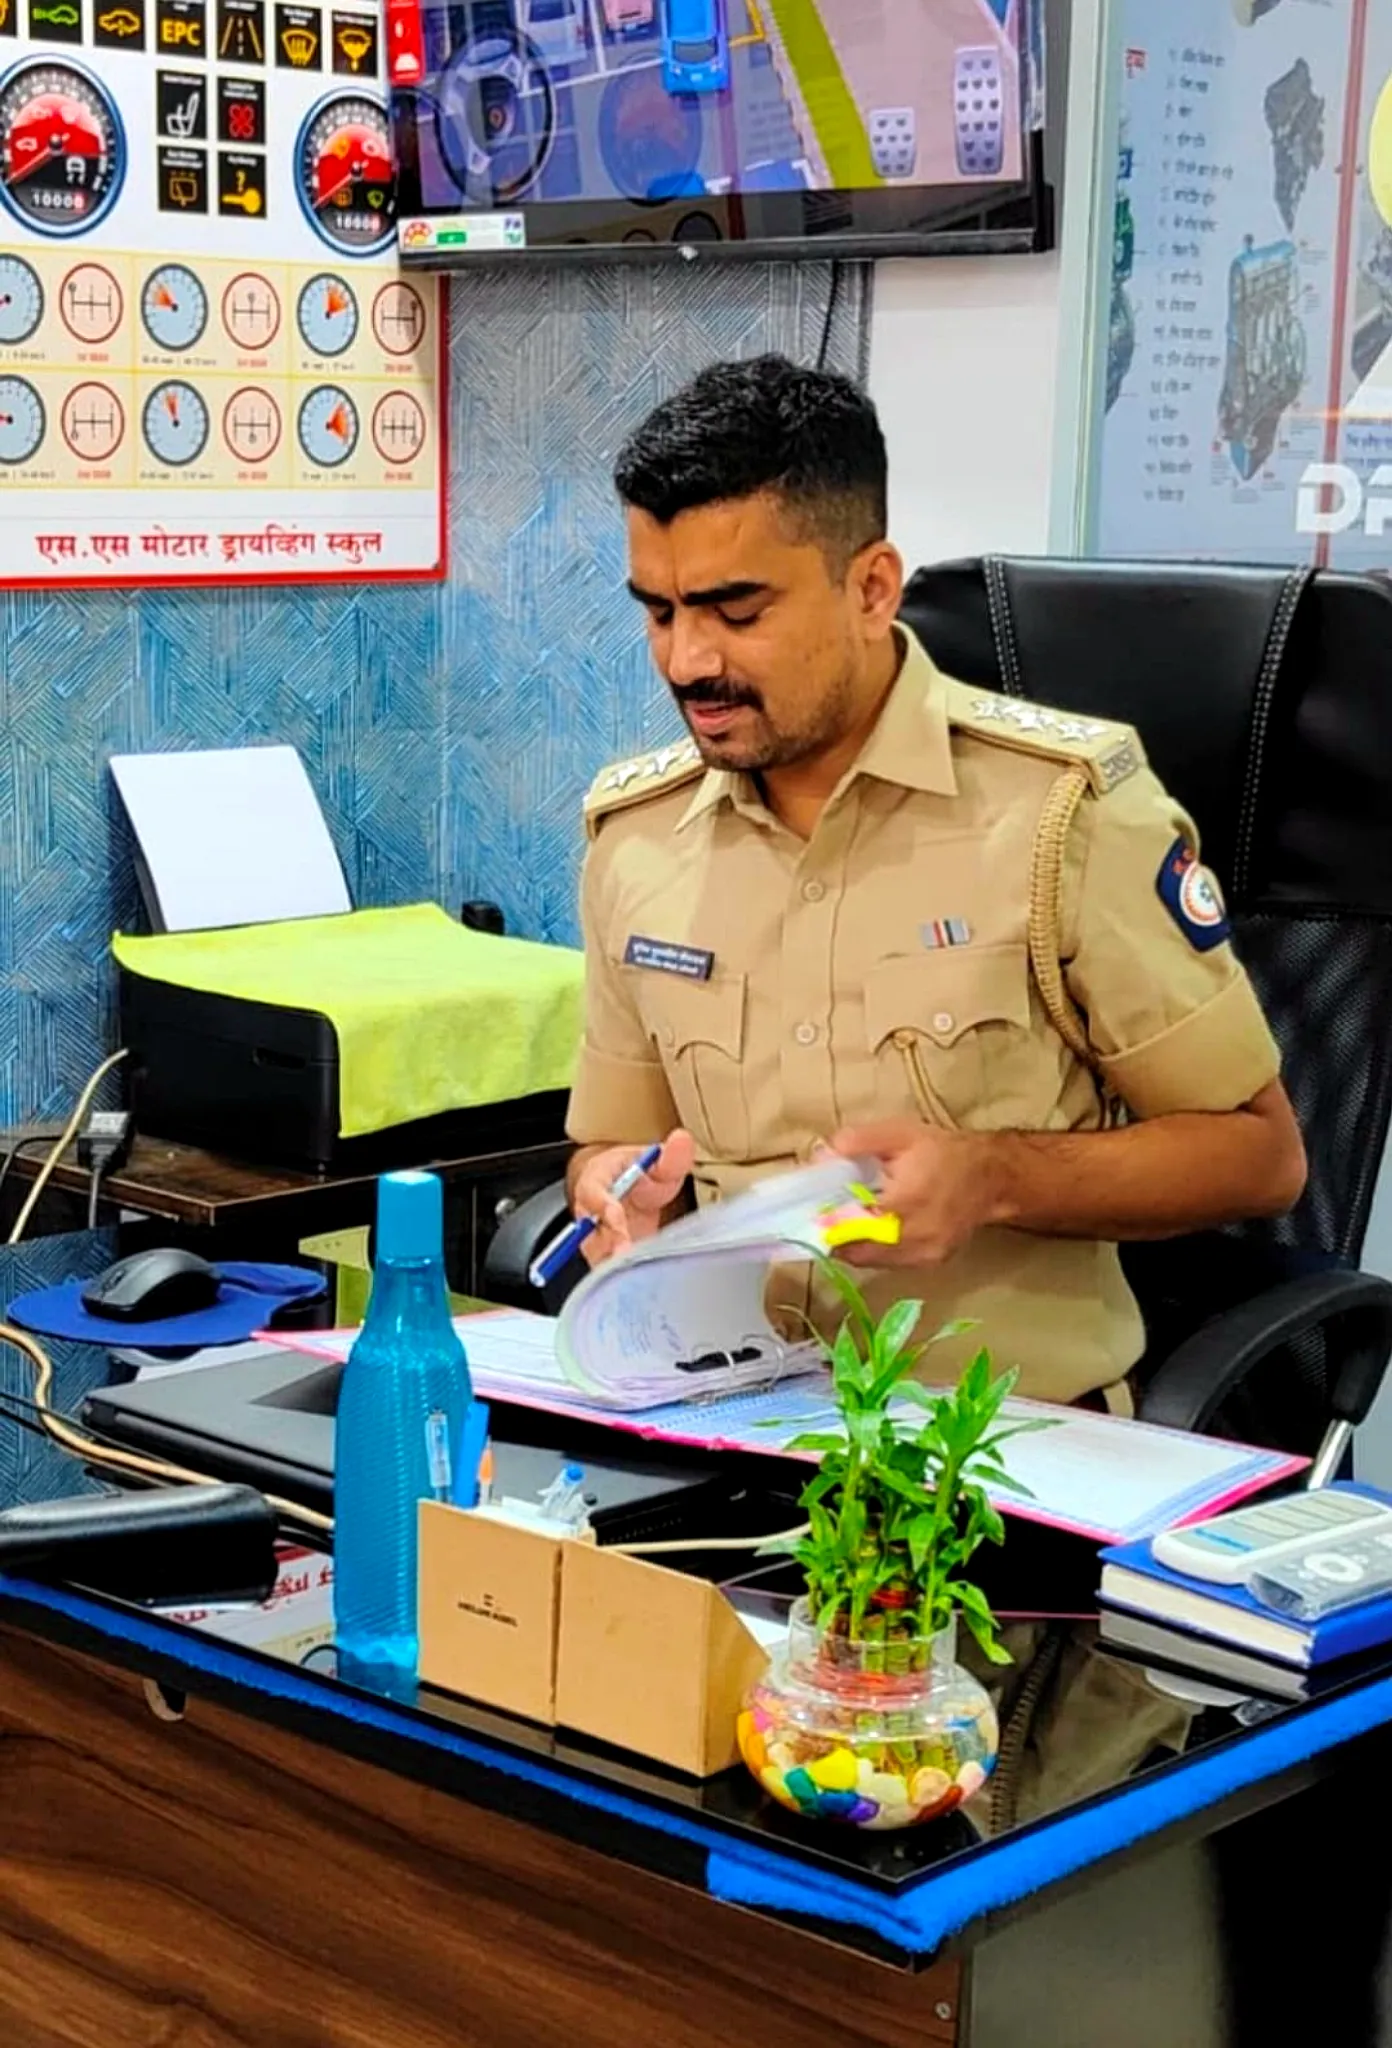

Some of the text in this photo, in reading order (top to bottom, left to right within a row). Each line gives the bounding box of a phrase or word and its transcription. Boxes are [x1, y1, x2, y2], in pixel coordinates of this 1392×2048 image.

[162, 19, 200, 46] EPC
[139, 524, 209, 557] मोटार
[218, 524, 316, 563] ड्रायव्हिंग
[326, 532, 382, 564] स्कुल
